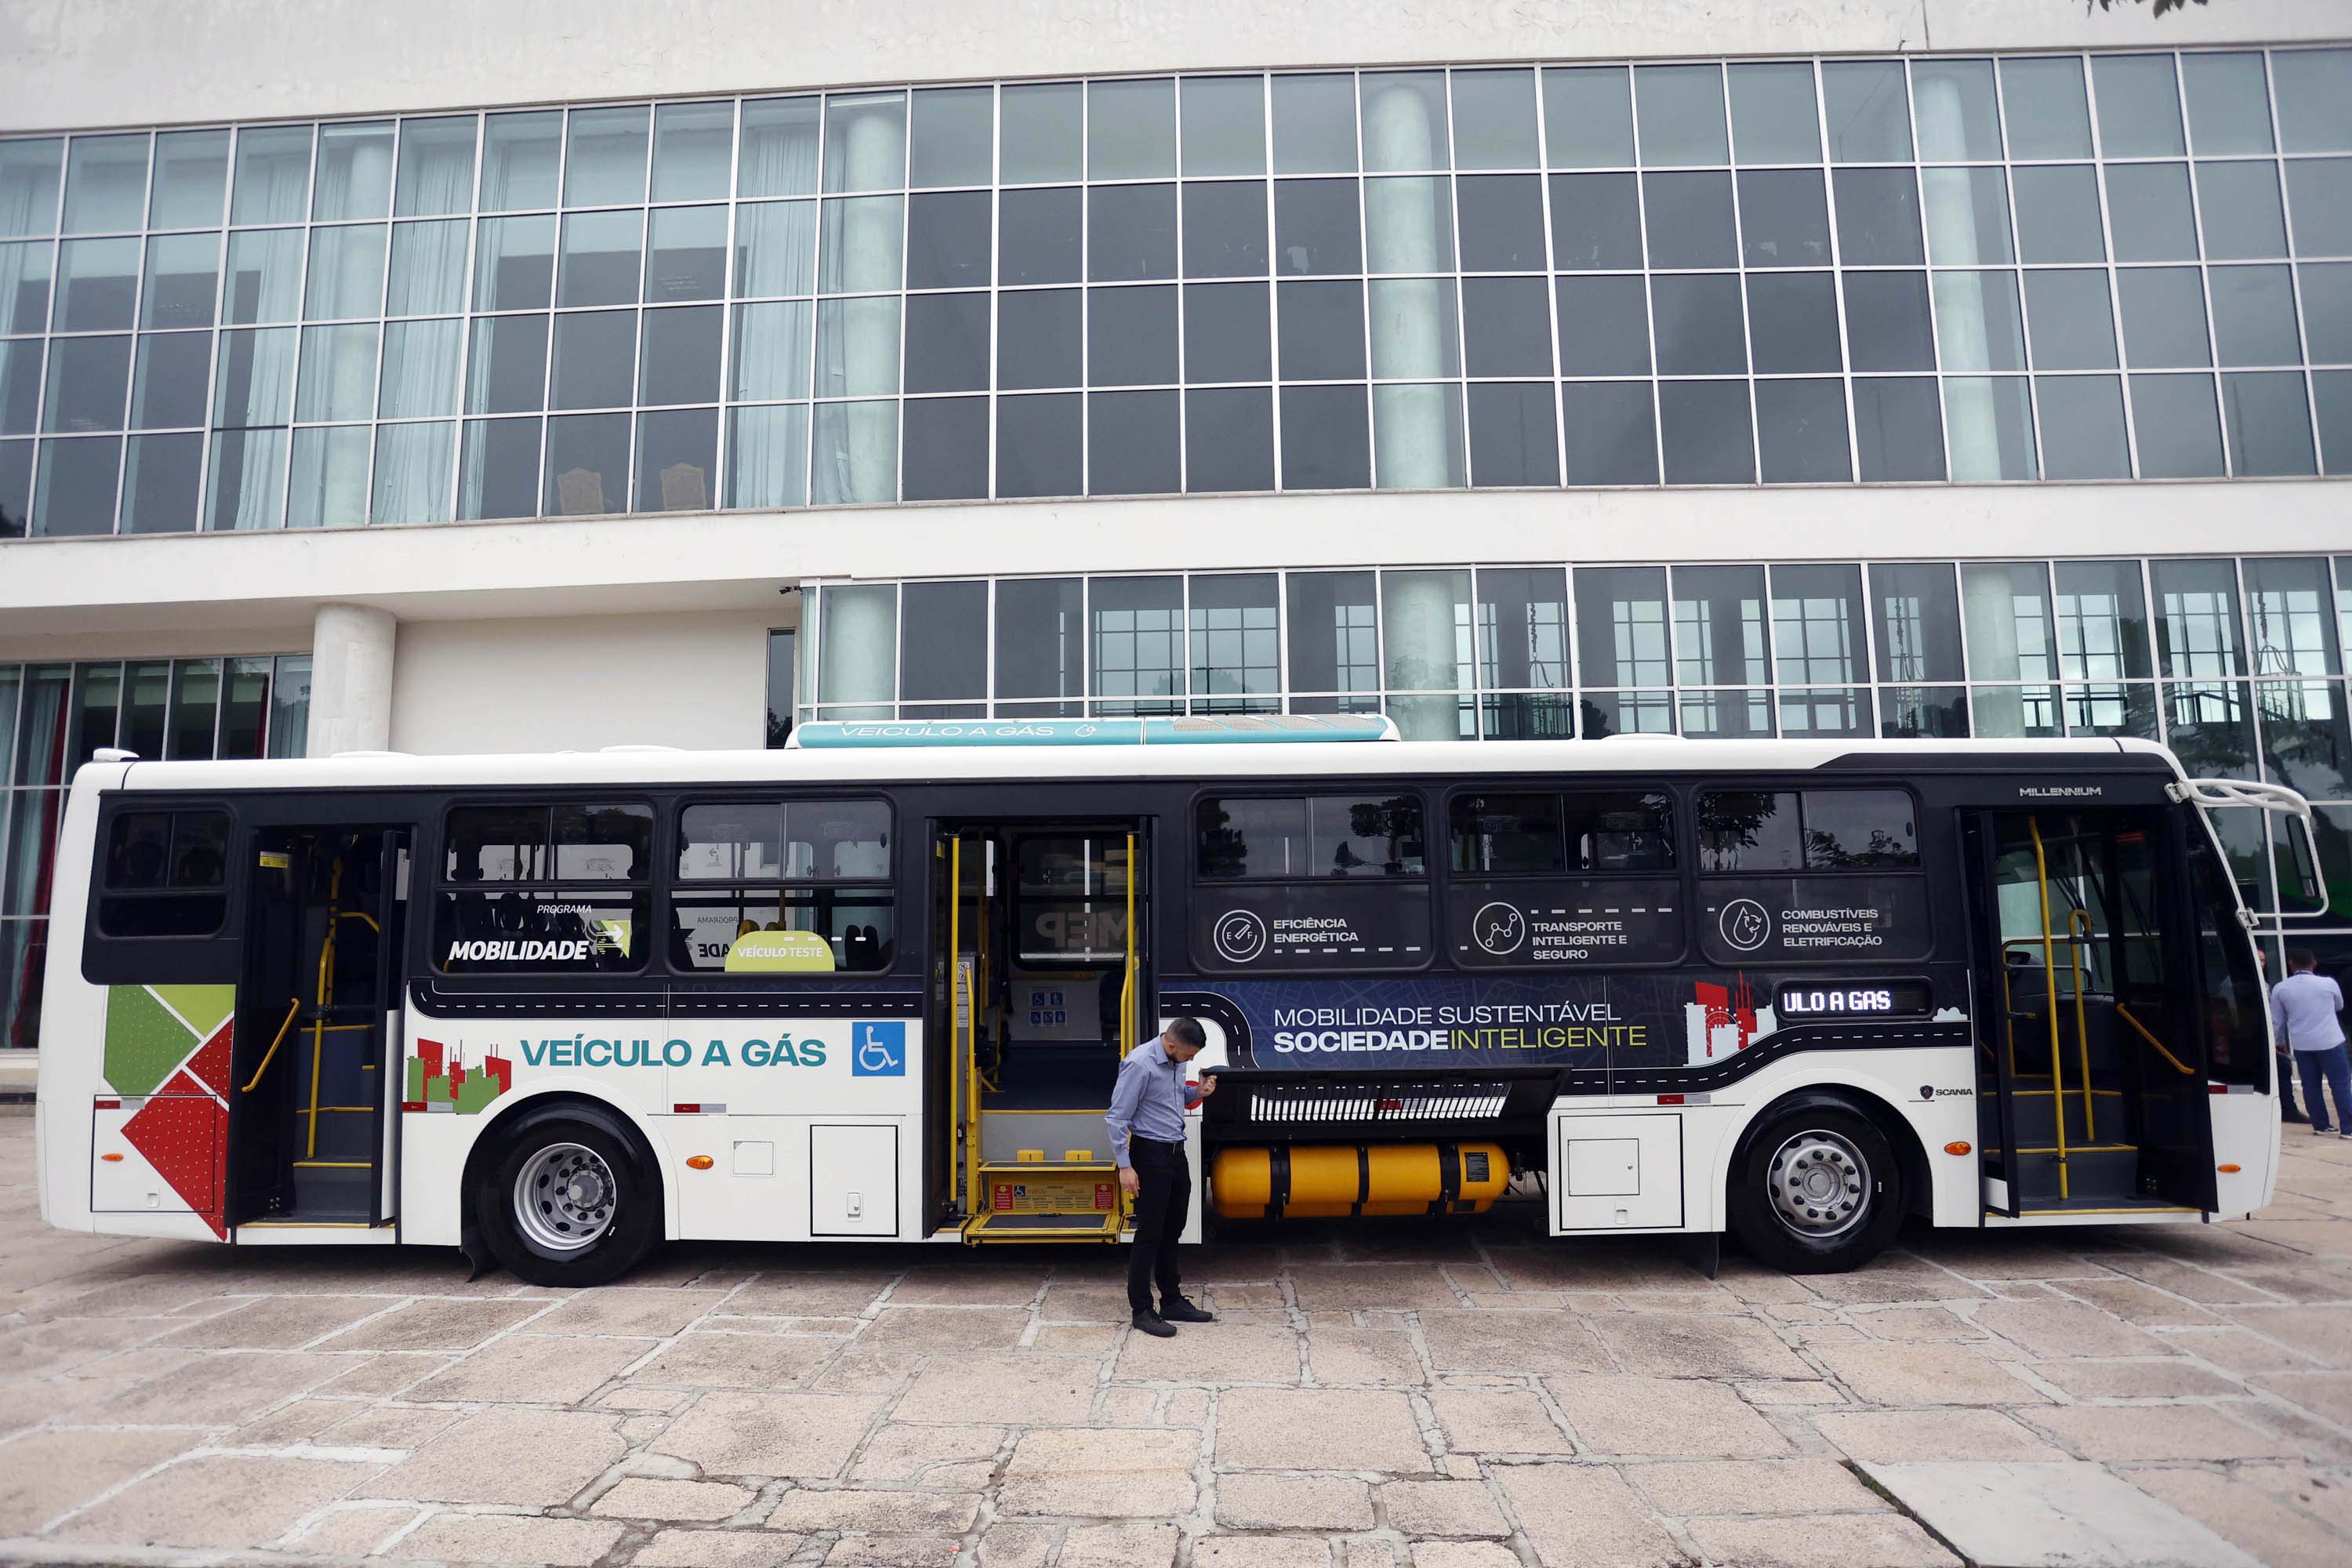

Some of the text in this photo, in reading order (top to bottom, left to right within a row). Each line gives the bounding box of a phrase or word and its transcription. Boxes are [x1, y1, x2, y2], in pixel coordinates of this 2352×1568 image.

[967, 726, 988, 736] A
[2019, 786, 2102, 797] MILLENNIUM
[536, 904, 592, 914] PROGRAMA
[1781, 907, 1878, 920] COMBUSTÍVEIS
[1273, 916, 1348, 929] EFICIÊNCIA
[1531, 921, 1622, 932] TRANSPORTE
[1782, 921, 1872, 933] RENOVÁVEIS E
[1226, 931, 1253, 940] E F
[1273, 931, 1359, 943] ENERGÉTICA
[1532, 935, 1628, 946] INTELIGENTE E
[1783, 935, 1882, 948] ELETRIFICAÇÃO
[448, 940, 590, 960] MOBILIDADE
[737, 944, 787, 957] VEÍCULO
[789, 946, 823, 957] TESTE
[1533, 949, 1588, 960] SEGURO
[1784, 991, 1892, 1012] ULO A GAS
[1274, 1000, 1621, 1027] MOBILIDADE SUSTENTÁVEL
[520, 1033, 827, 1068] VEÍCULO A GÁS
